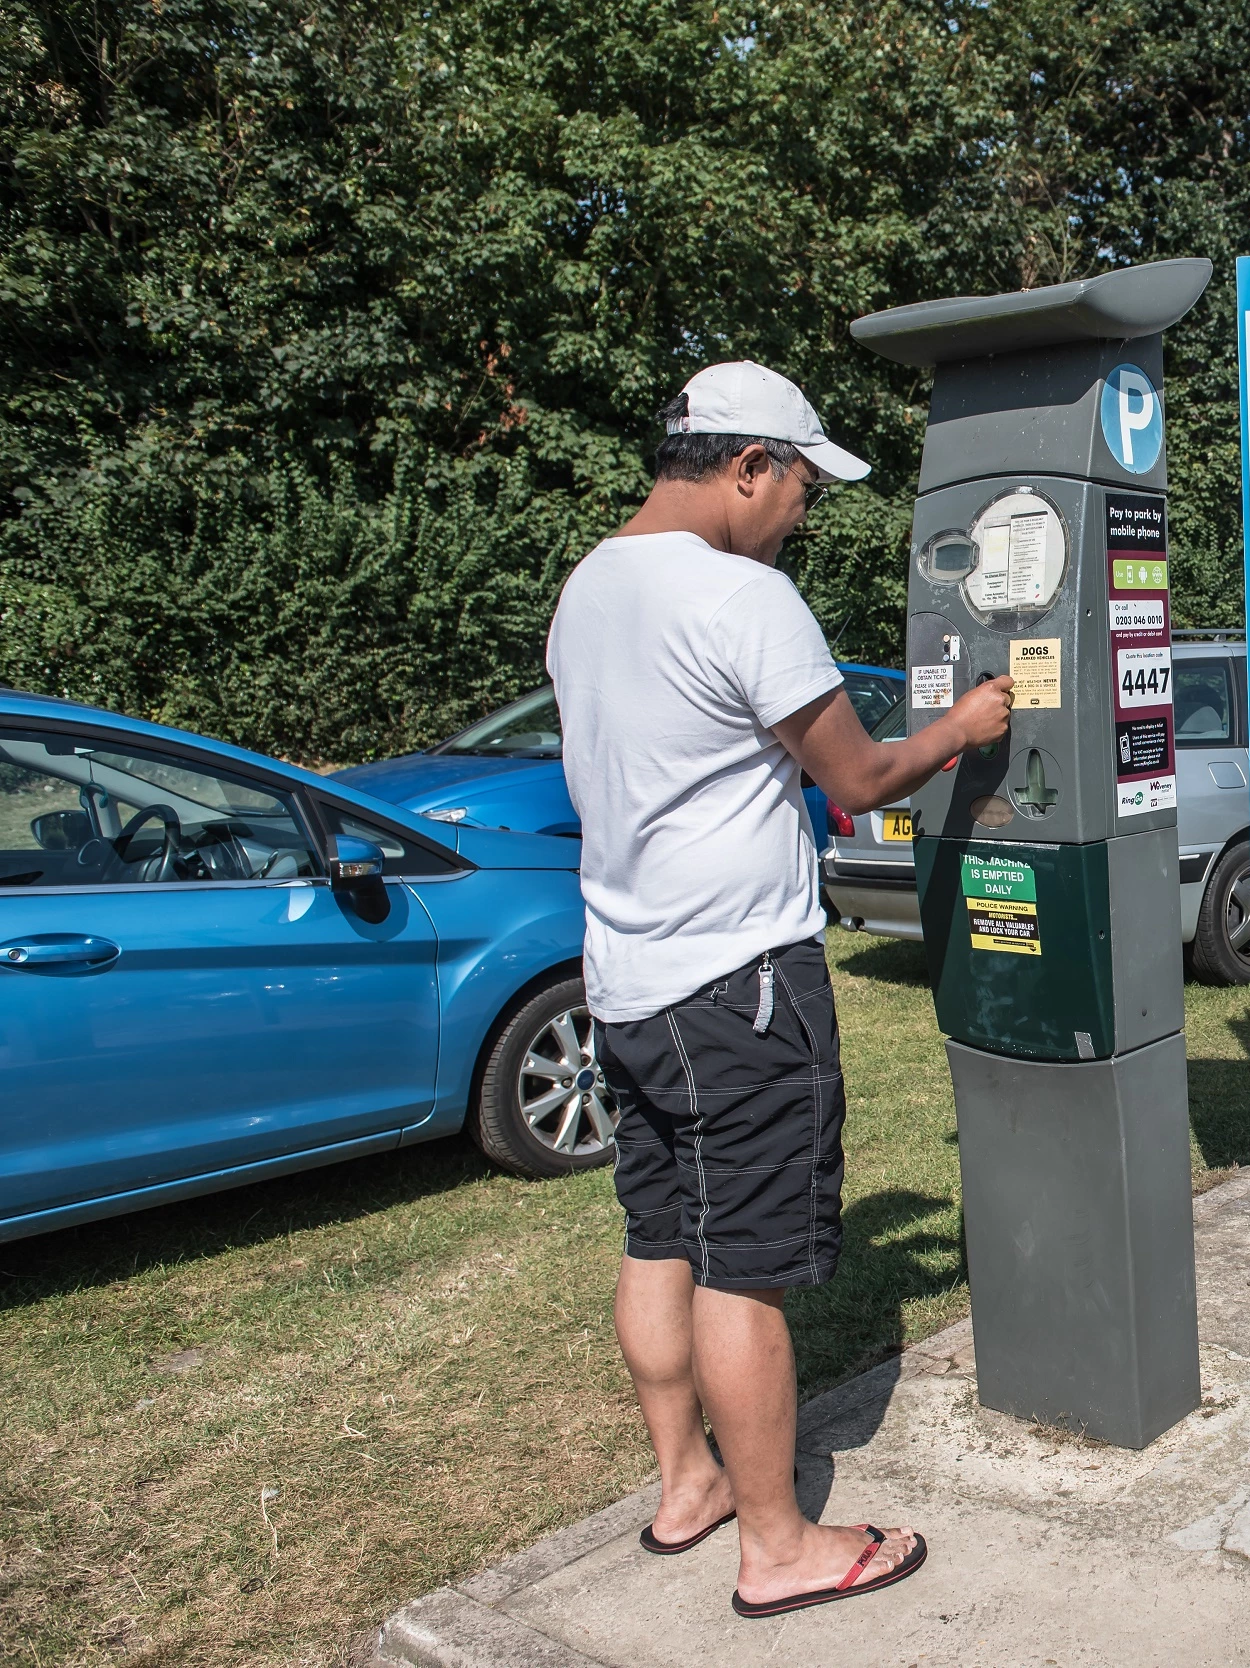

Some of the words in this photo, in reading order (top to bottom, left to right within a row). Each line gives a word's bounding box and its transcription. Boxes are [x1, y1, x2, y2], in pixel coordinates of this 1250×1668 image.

[1119, 369, 1153, 464] P
[1110, 507, 1123, 520] Pay
[1125, 508, 1132, 518] to
[1134, 509, 1151, 521] park
[1153, 509, 1161, 523] by
[1110, 525, 1135, 536] mobile
[1137, 526, 1159, 539] phone
[1115, 616, 1131, 625] 0203
[1133, 616, 1145, 624] 046
[1147, 615, 1164, 625] 0010
[1022, 646, 1048, 655] DOGS
[1122, 668, 1170, 696] 4447
[971, 869, 980, 878] IS
[982, 870, 1024, 881] EMPTIED
[985, 884, 1012, 894] DAILY
[1006, 922, 1034, 930] VALUABLES
